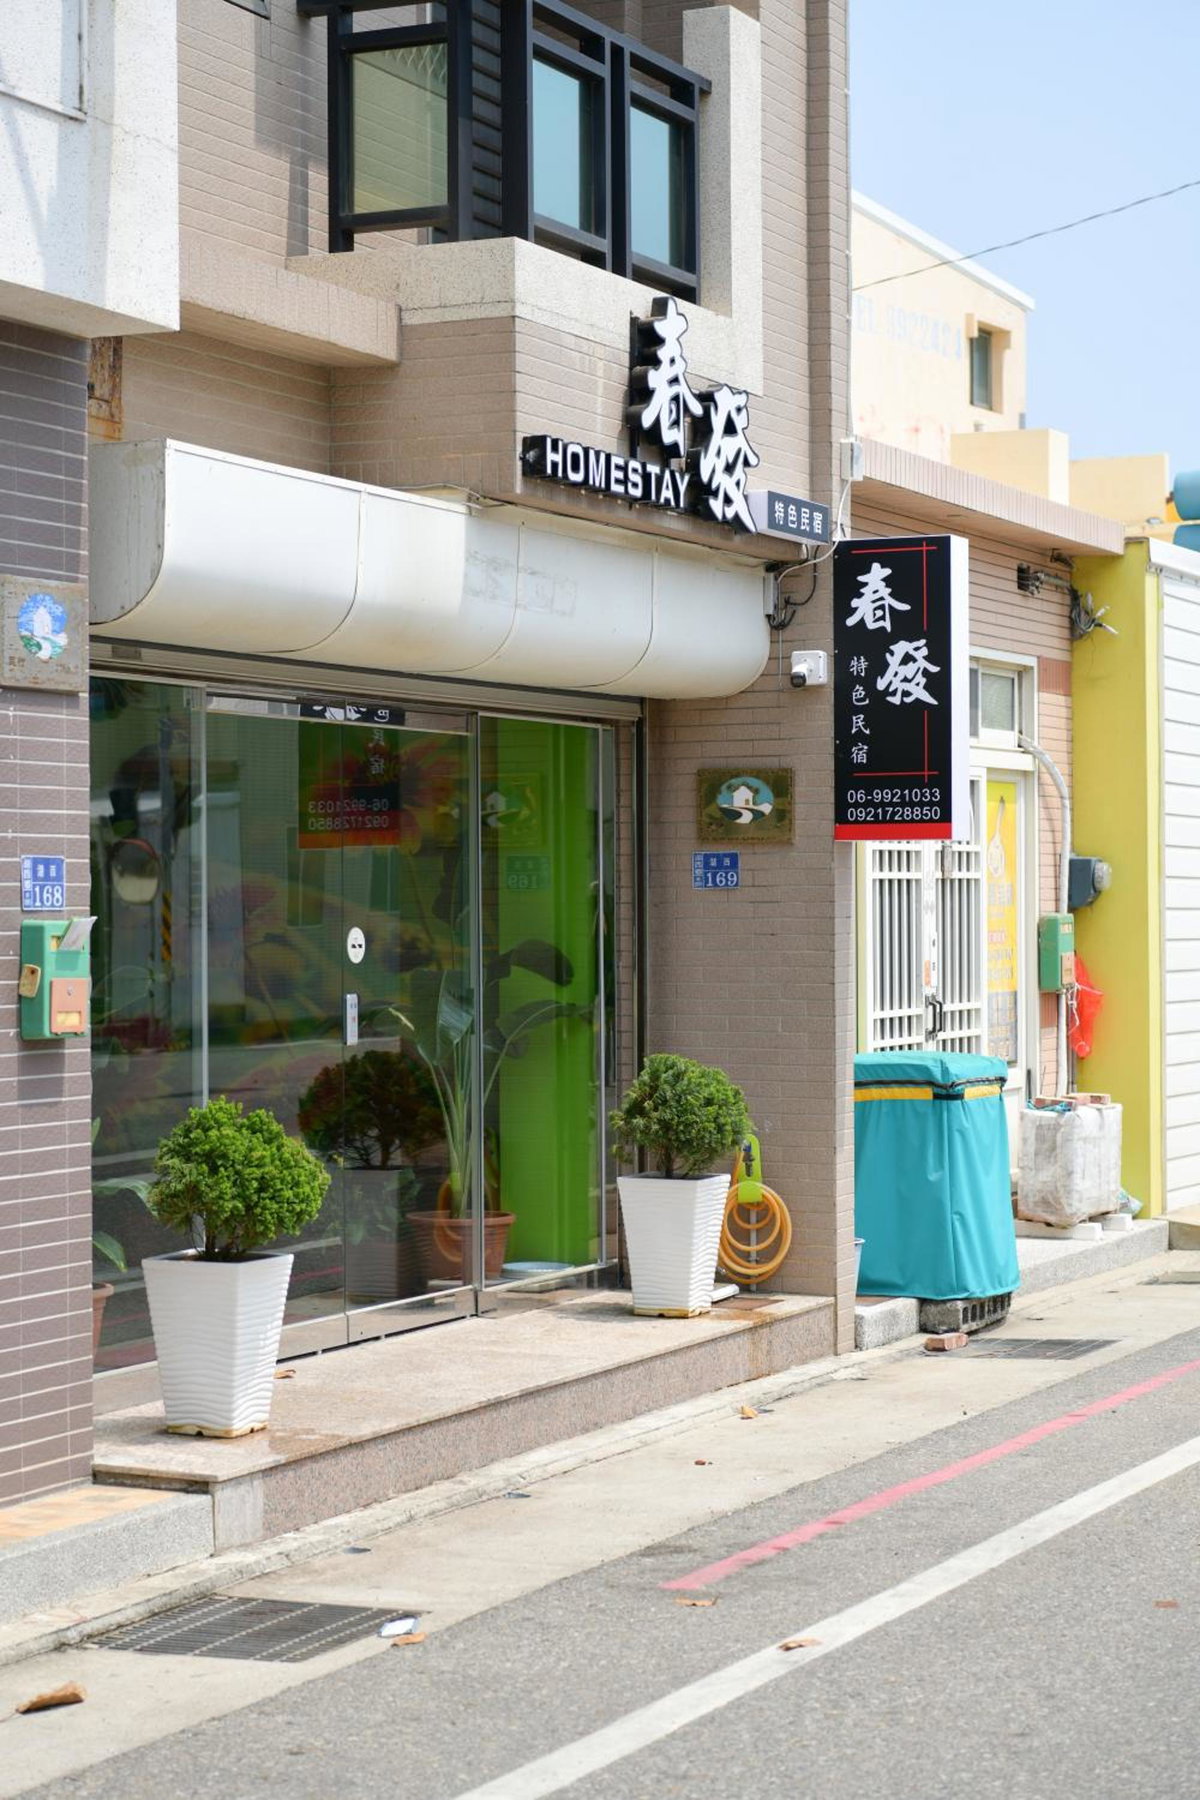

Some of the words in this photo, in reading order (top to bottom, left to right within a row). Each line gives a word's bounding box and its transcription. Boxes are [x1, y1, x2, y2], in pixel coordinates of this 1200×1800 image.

[641, 297, 760, 534] 春發
[545, 437, 691, 508] HOMESTAY
[774, 500, 823, 534] 特色民宿
[845, 562, 941, 706] 春發
[849, 655, 870, 765] 特色民宿
[847, 787, 941, 804] 06-9921033
[847, 806, 941, 822] 0921728850
[34, 885, 62, 907] 168
[706, 871, 738, 887] 169
